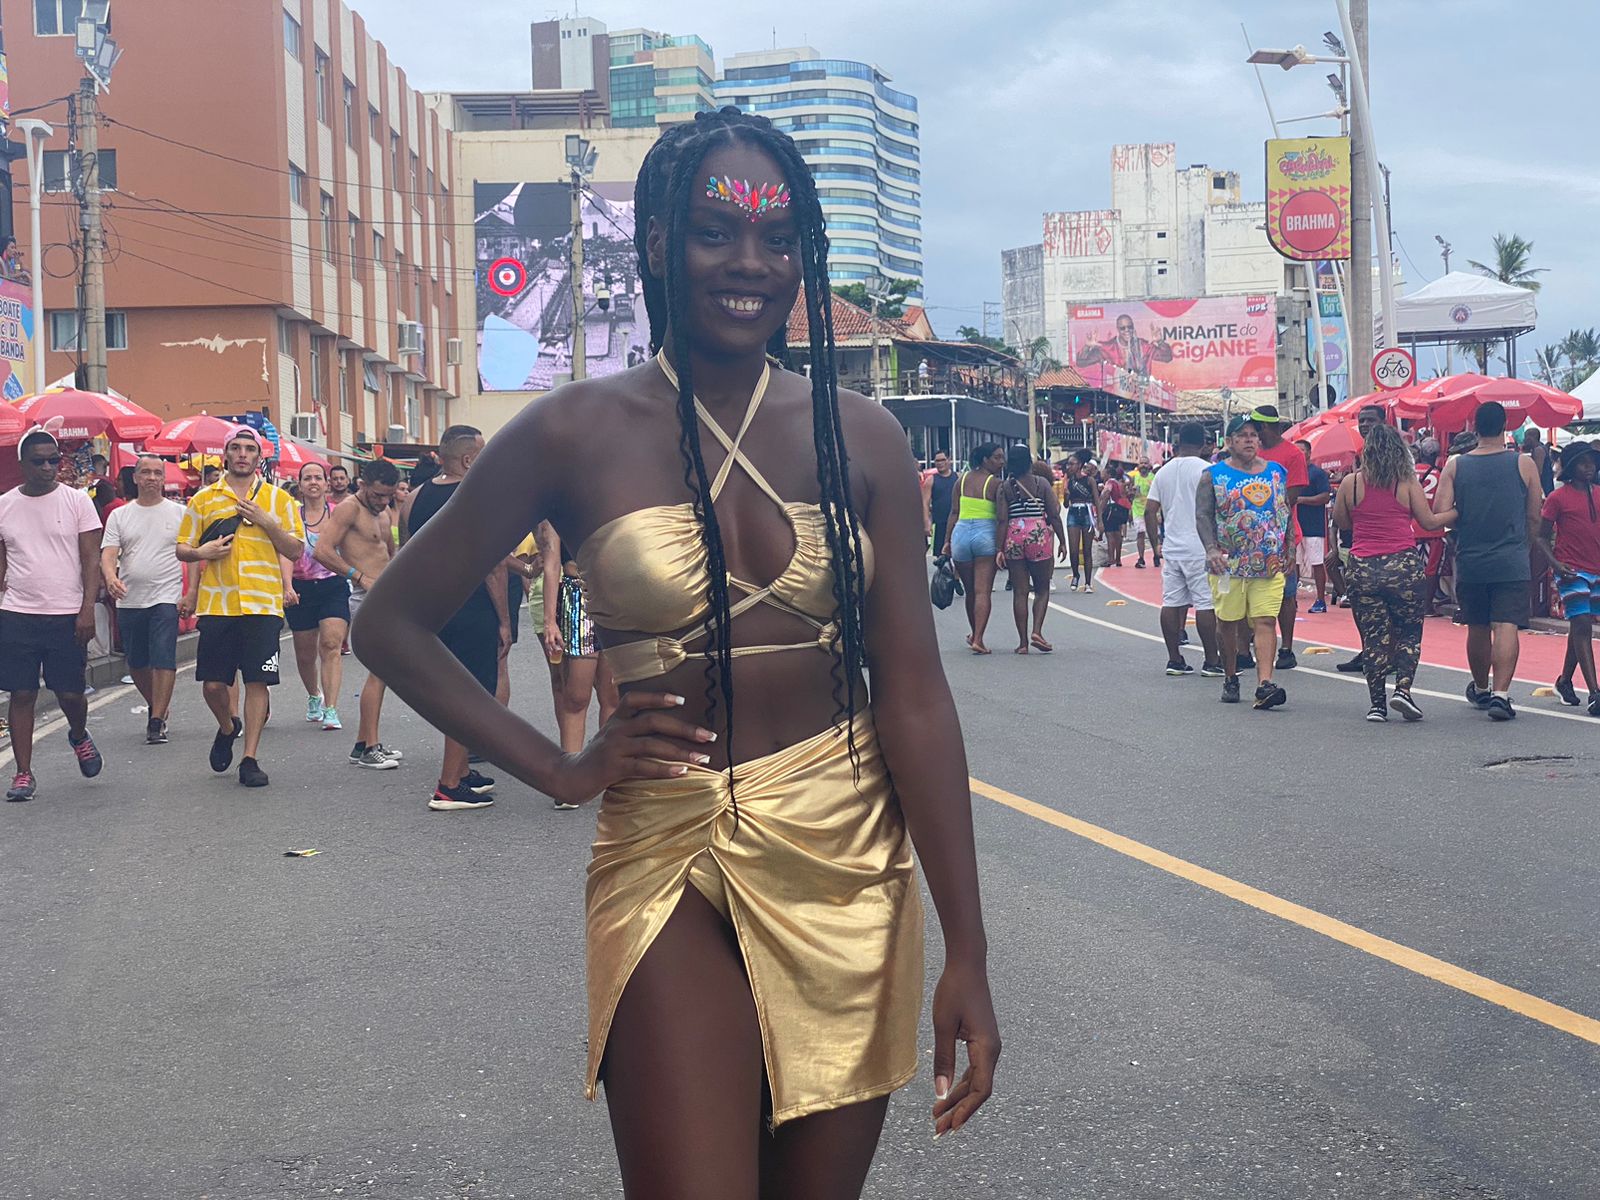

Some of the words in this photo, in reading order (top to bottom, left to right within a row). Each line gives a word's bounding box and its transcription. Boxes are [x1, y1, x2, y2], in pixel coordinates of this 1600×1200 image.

[1286, 213, 1336, 232] BRAHMA
[1162, 323, 1237, 340] MiRAnTE
[1240, 323, 1257, 336] do
[0, 341, 25, 360] BANDA
[1171, 338, 1258, 363] GigANtE
[59, 427, 89, 438] BRAHMA
